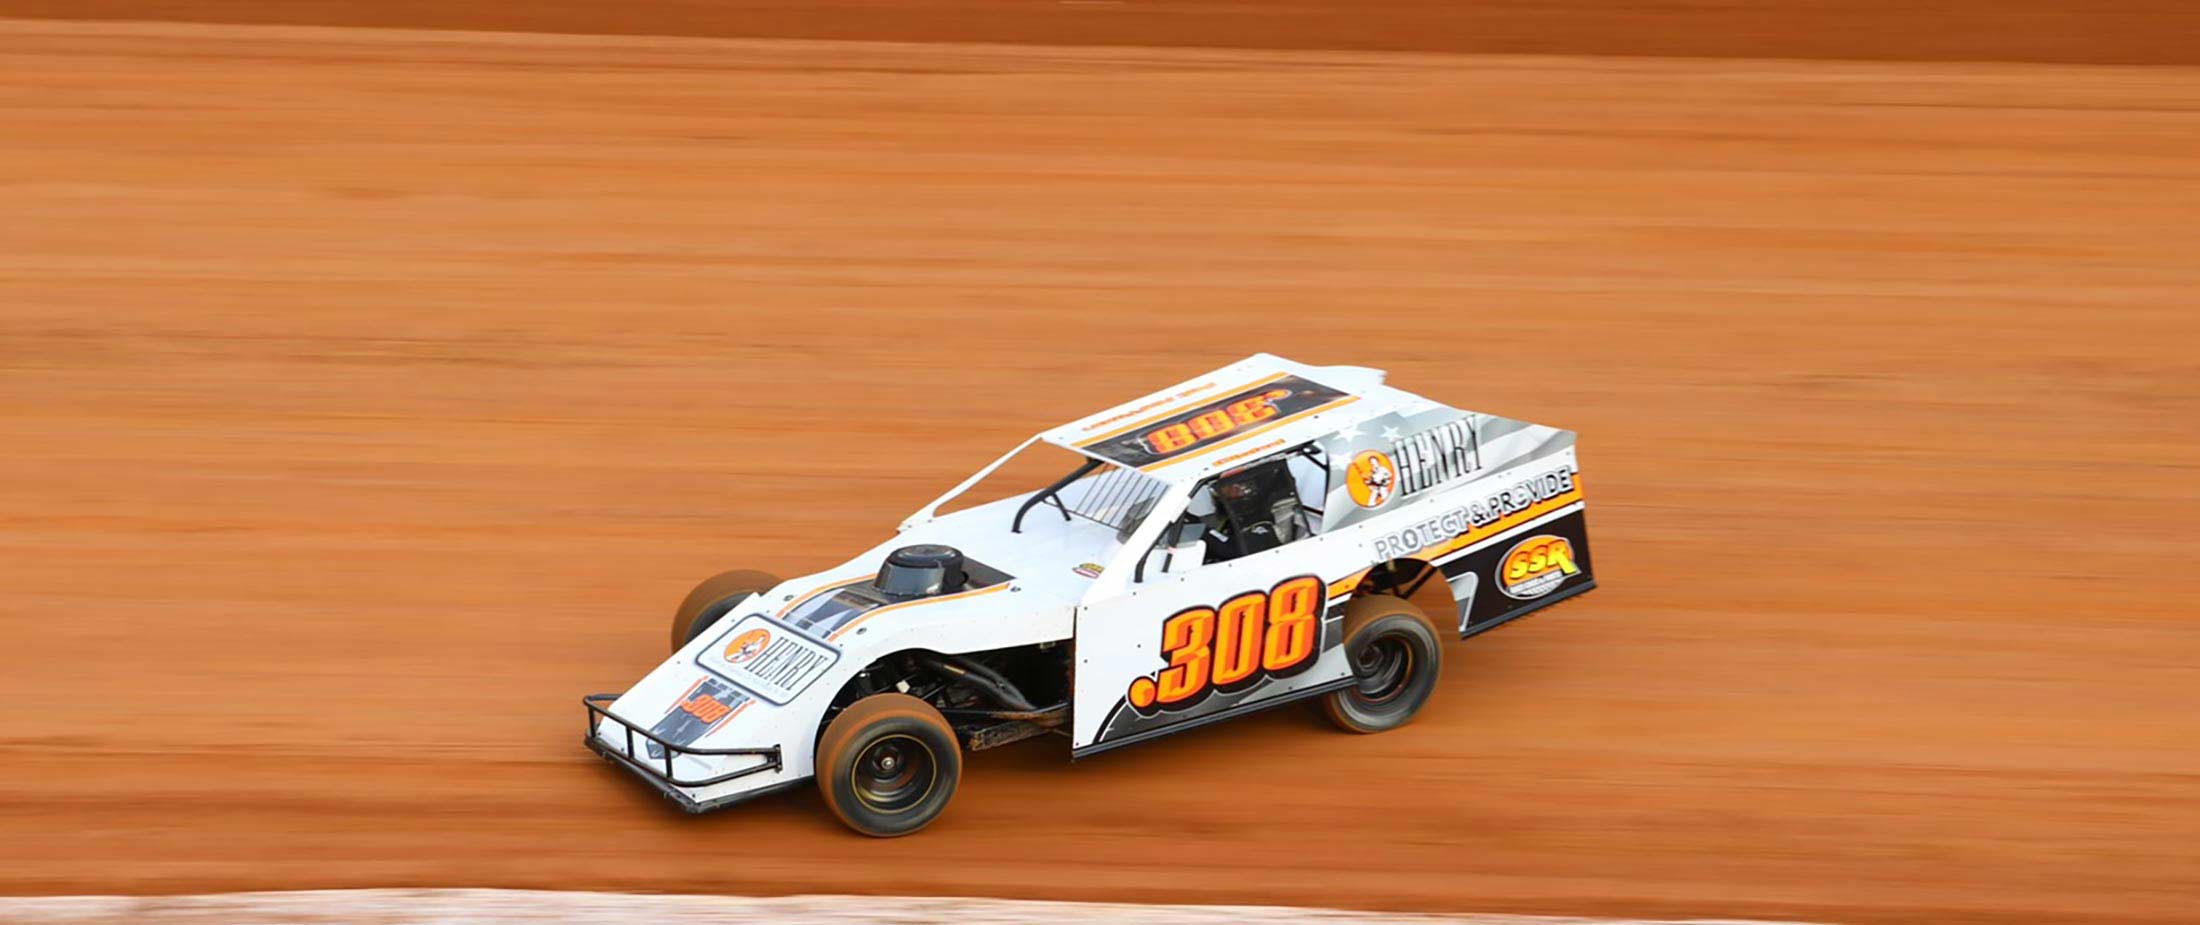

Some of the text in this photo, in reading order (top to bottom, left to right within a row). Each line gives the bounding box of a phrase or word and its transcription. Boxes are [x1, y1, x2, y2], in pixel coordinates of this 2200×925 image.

[1393, 415, 1483, 497] HENRY
[1373, 503, 1470, 561] PROTECT
[1489, 465, 1574, 519] PROVIDE
[1510, 540, 1577, 579] SSR
[745, 636, 829, 692] HENRY
[1127, 574, 1322, 709] .308
